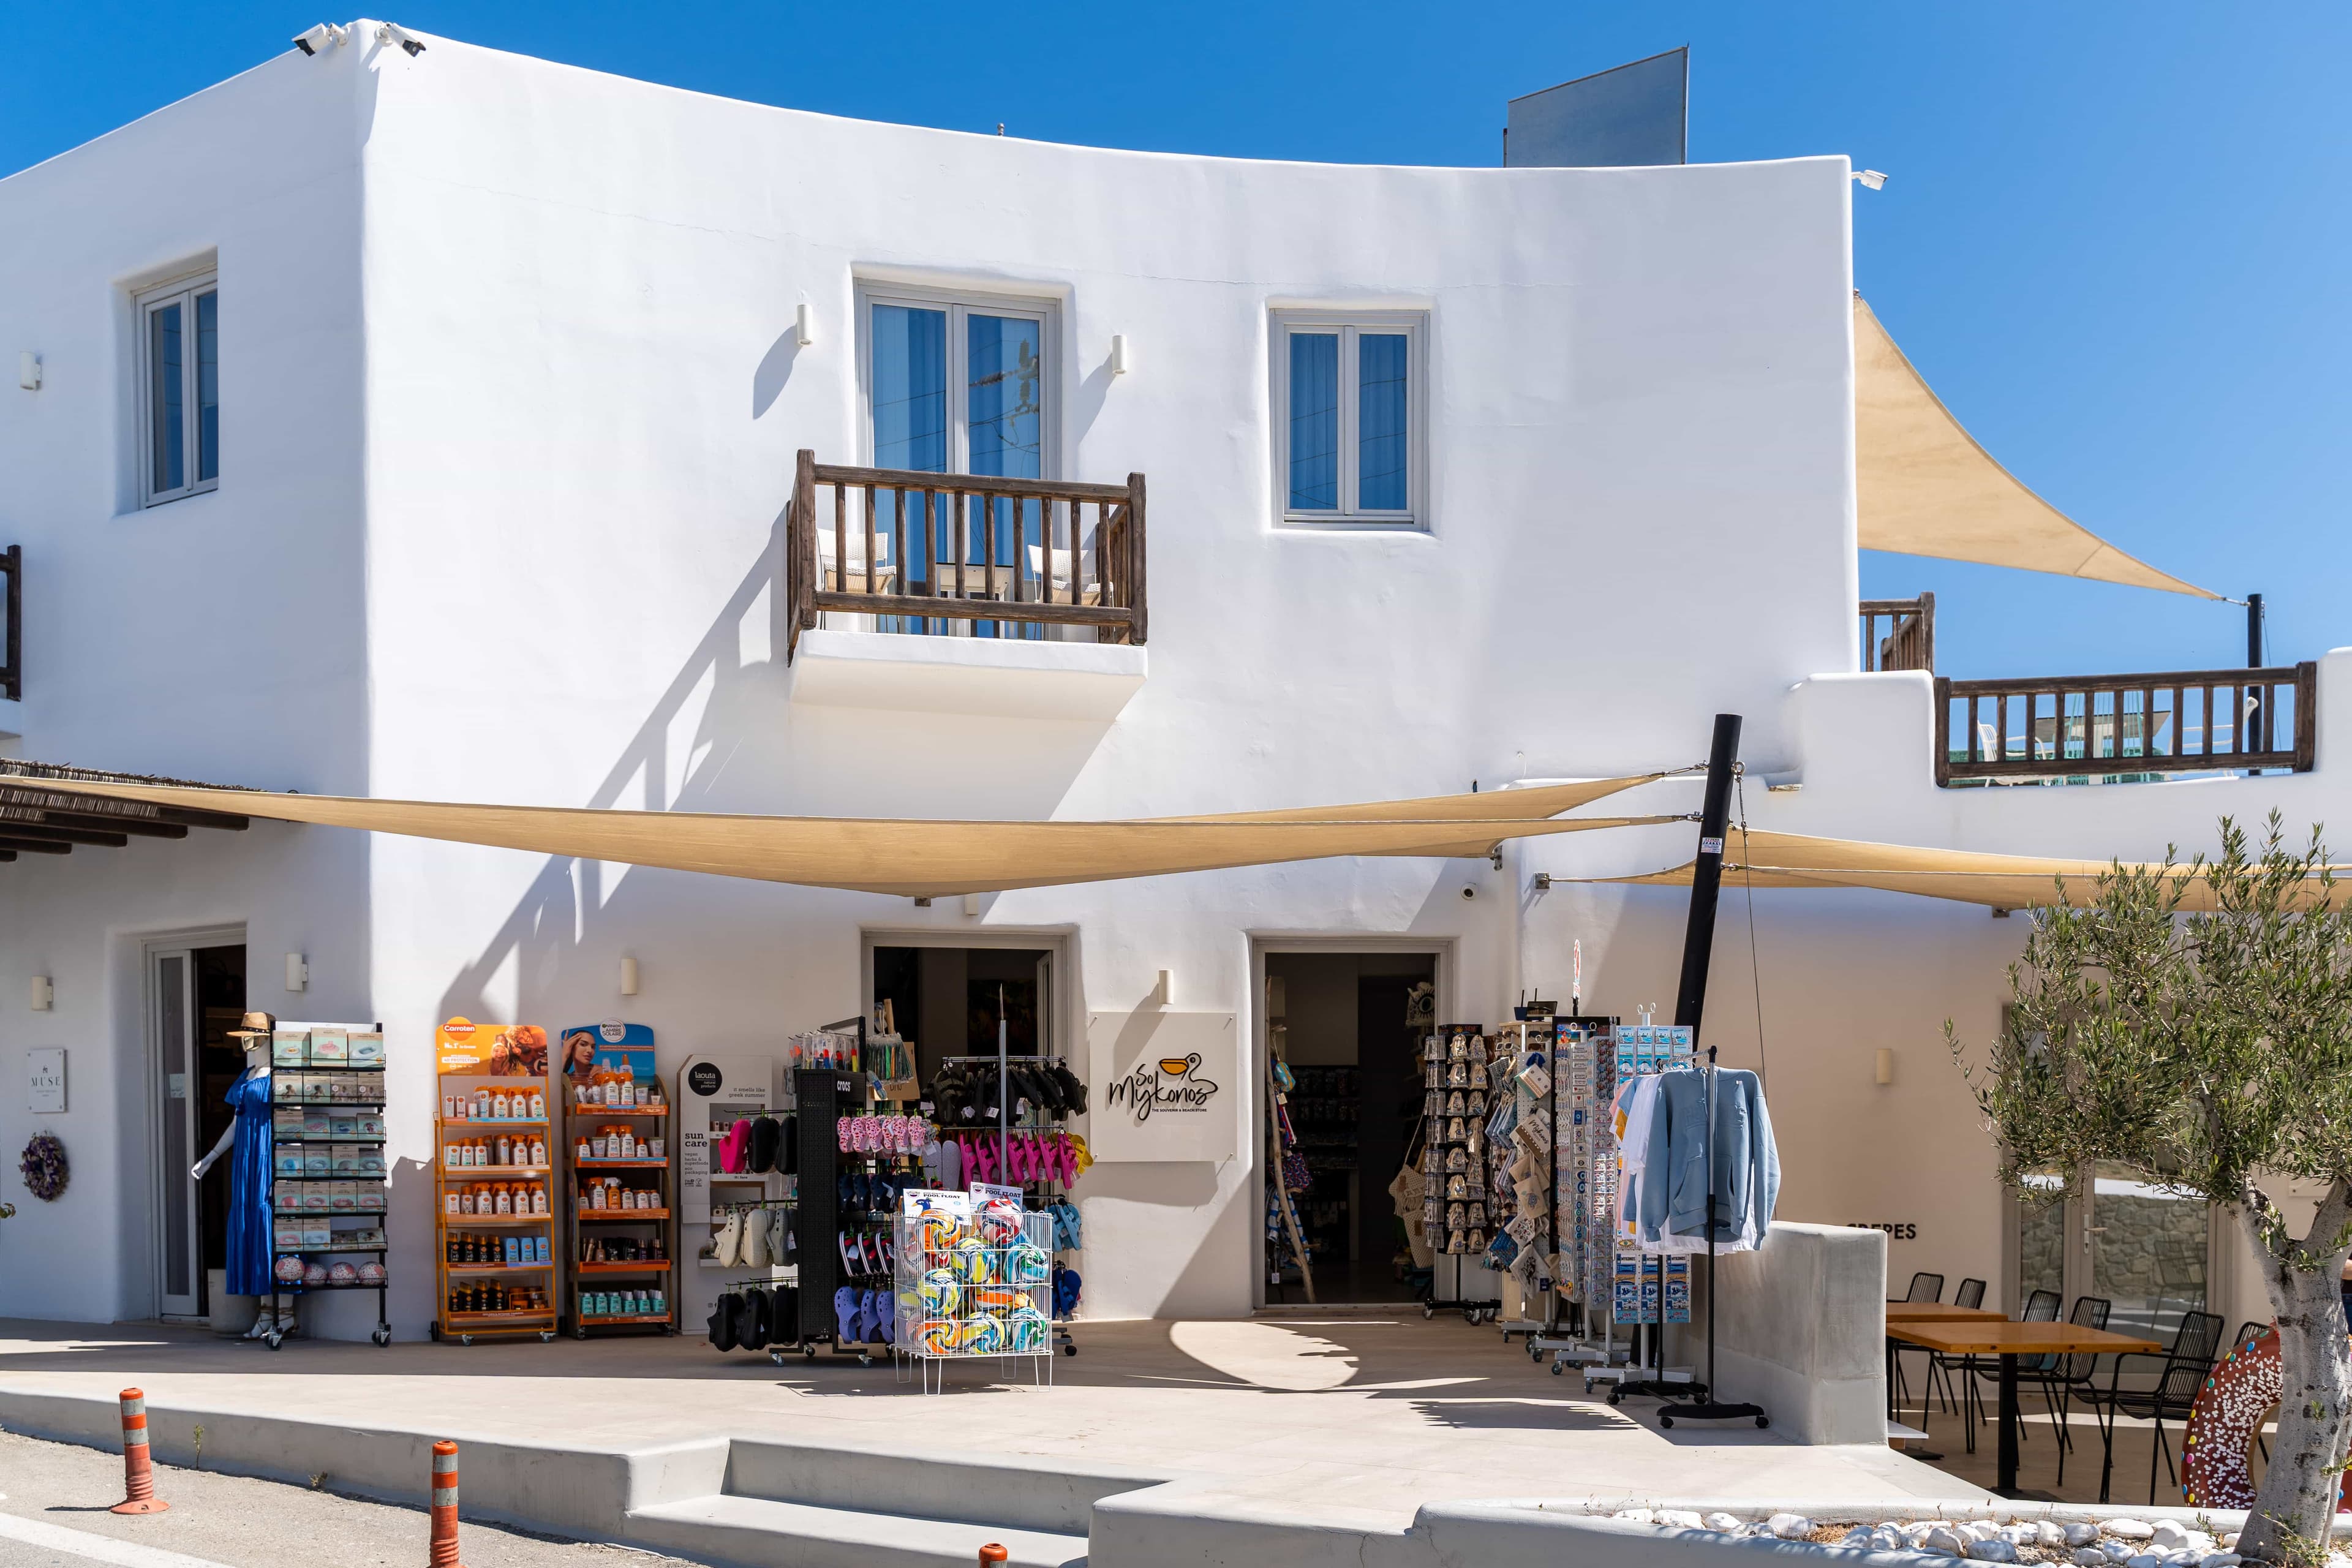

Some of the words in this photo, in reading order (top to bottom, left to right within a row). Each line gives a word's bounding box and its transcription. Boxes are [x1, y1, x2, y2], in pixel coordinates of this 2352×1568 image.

[31, 1076, 60, 1087] MUSE
[1136, 1064, 1153, 1087] So
[837, 1080, 850, 1092] crocs
[1109, 1071, 1207, 1121] Mykonos
